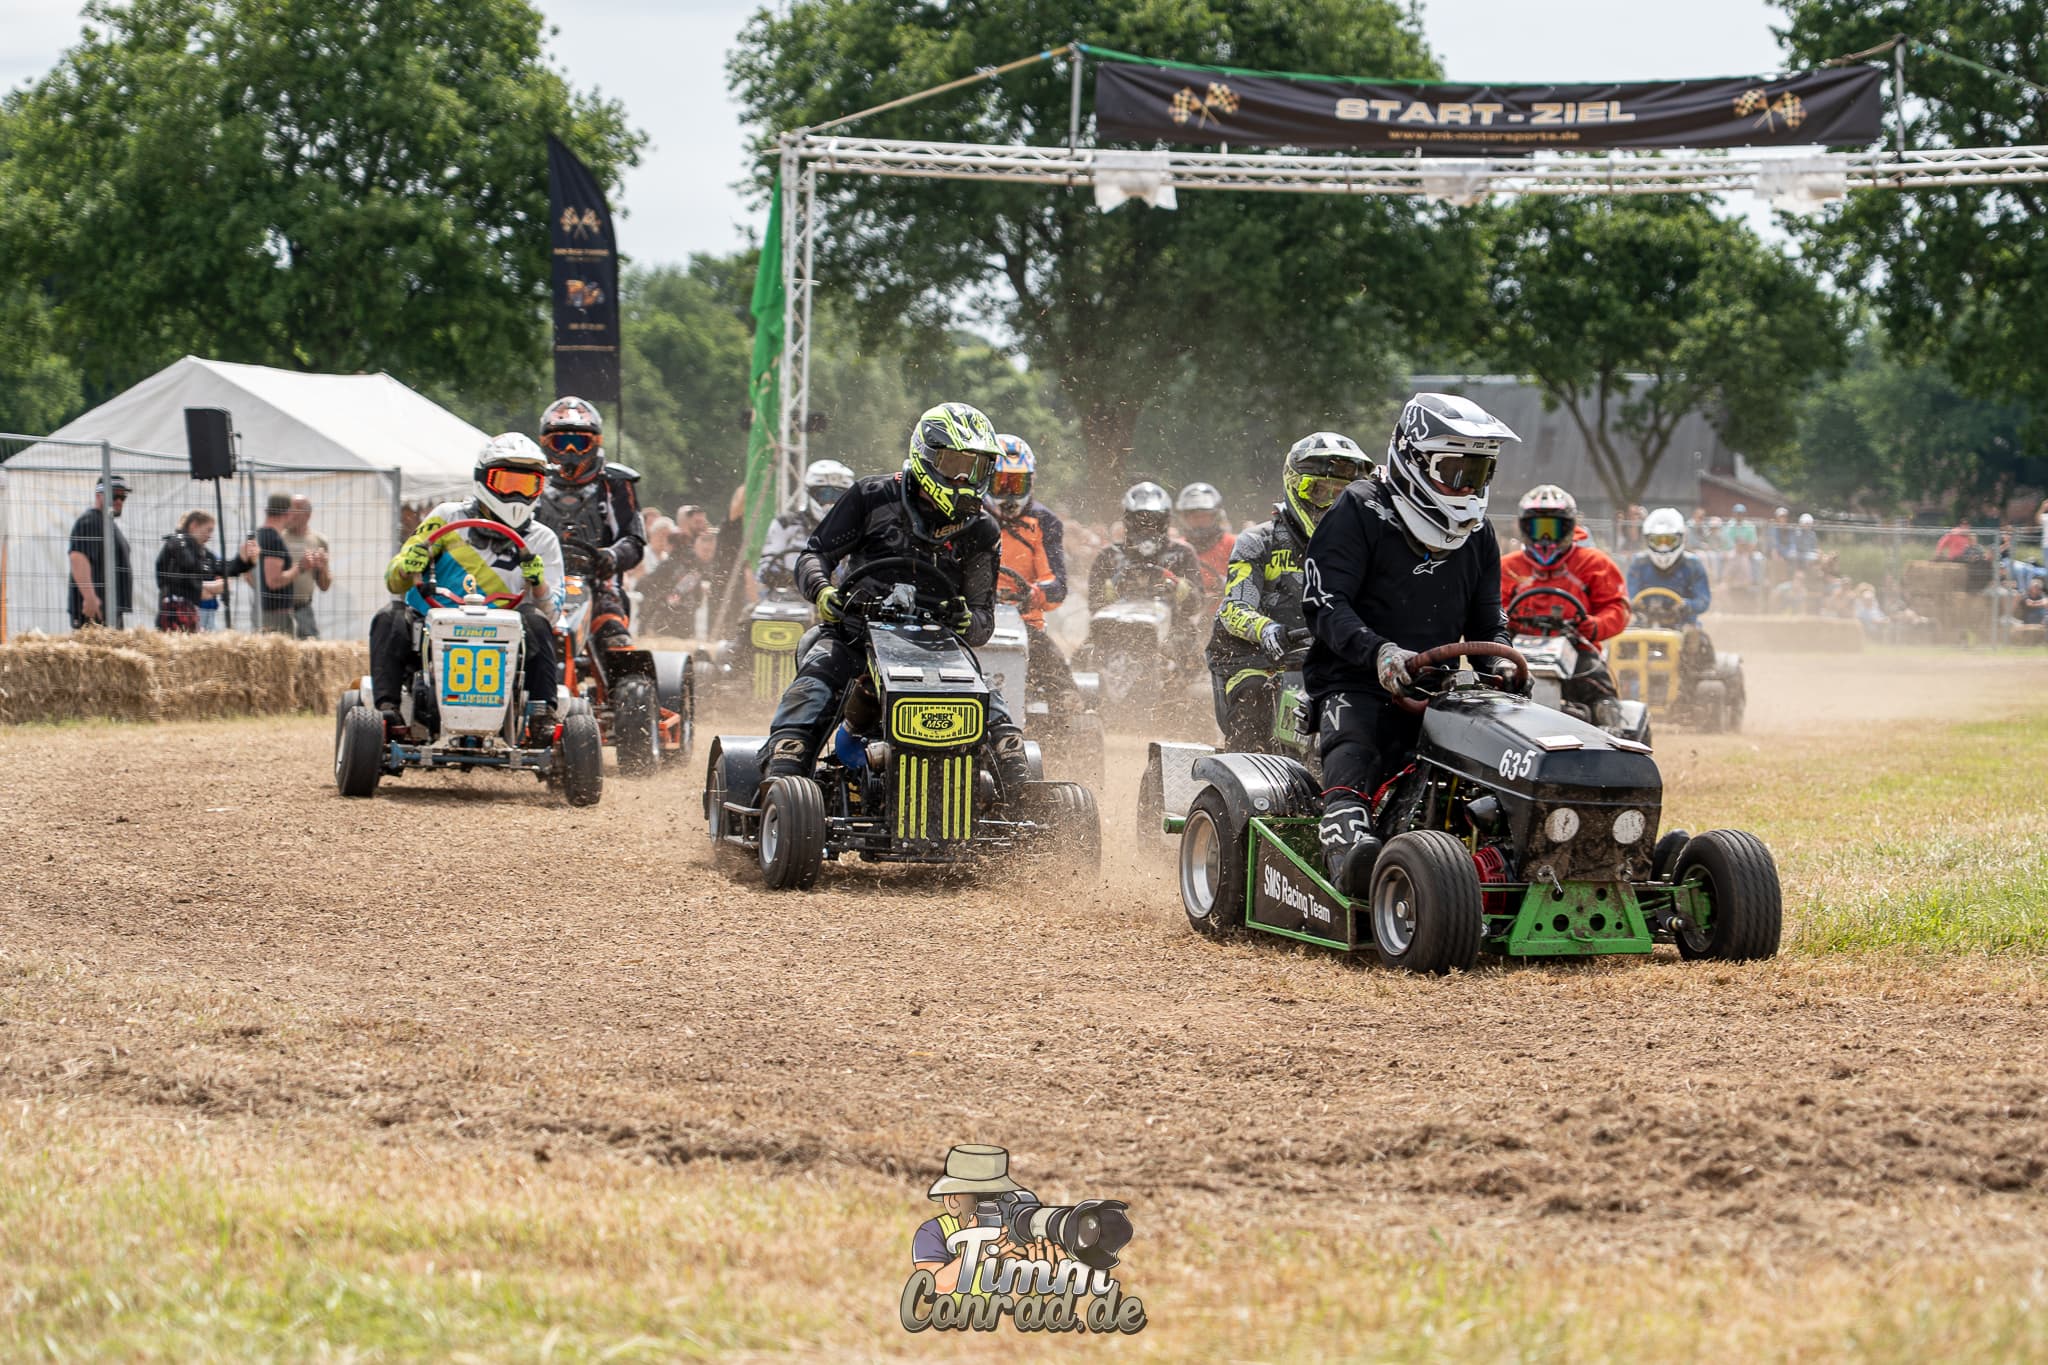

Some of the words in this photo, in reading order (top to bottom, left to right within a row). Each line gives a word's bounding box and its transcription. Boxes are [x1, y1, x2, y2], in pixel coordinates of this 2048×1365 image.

[448, 648, 500, 693] 88
[926, 720, 949, 729] MSG
[1499, 749, 1537, 781] 635
[1264, 864, 1281, 900] SMS
[1282, 875, 1308, 919] Racing
[1308, 893, 1331, 923] Team
